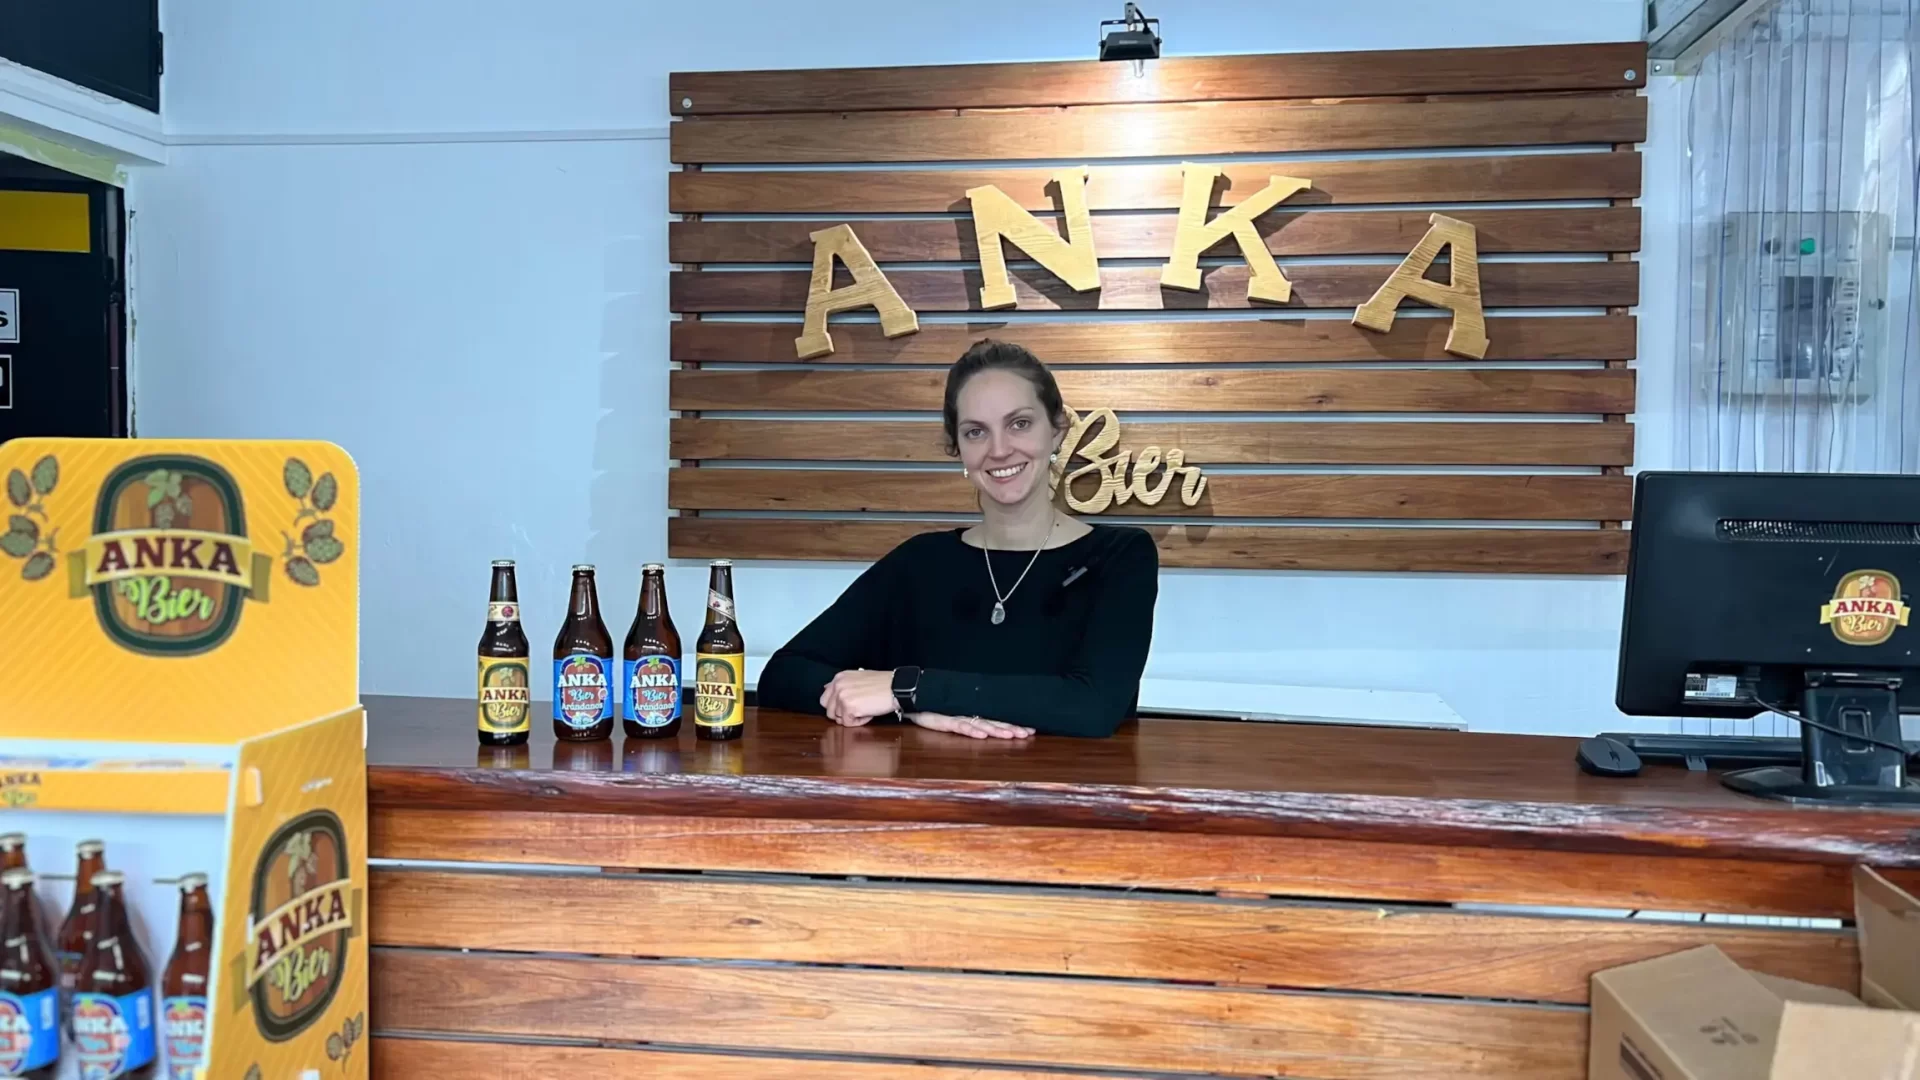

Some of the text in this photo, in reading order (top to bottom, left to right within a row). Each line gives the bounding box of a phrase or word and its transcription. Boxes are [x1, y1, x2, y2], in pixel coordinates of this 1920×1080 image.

[795, 162, 1490, 360] ANKA
[1049, 404, 1208, 514] Bier
[96, 536, 242, 576] ANKA
[116, 576, 216, 625] Bier
[1834, 600, 1897, 616] ANKA
[1843, 615, 1882, 632] Bier
[558, 673, 608, 688] ANKA
[630, 673, 678, 688] ANKA
[483, 689, 528, 701] ANKA
[568, 689, 595, 701] Bier
[641, 689, 668, 702] Bier
[489, 701, 520, 718] Bier
[698, 696, 725, 713] Bier
[254, 888, 347, 973] ANKA
[270, 946, 330, 1002] Bier
